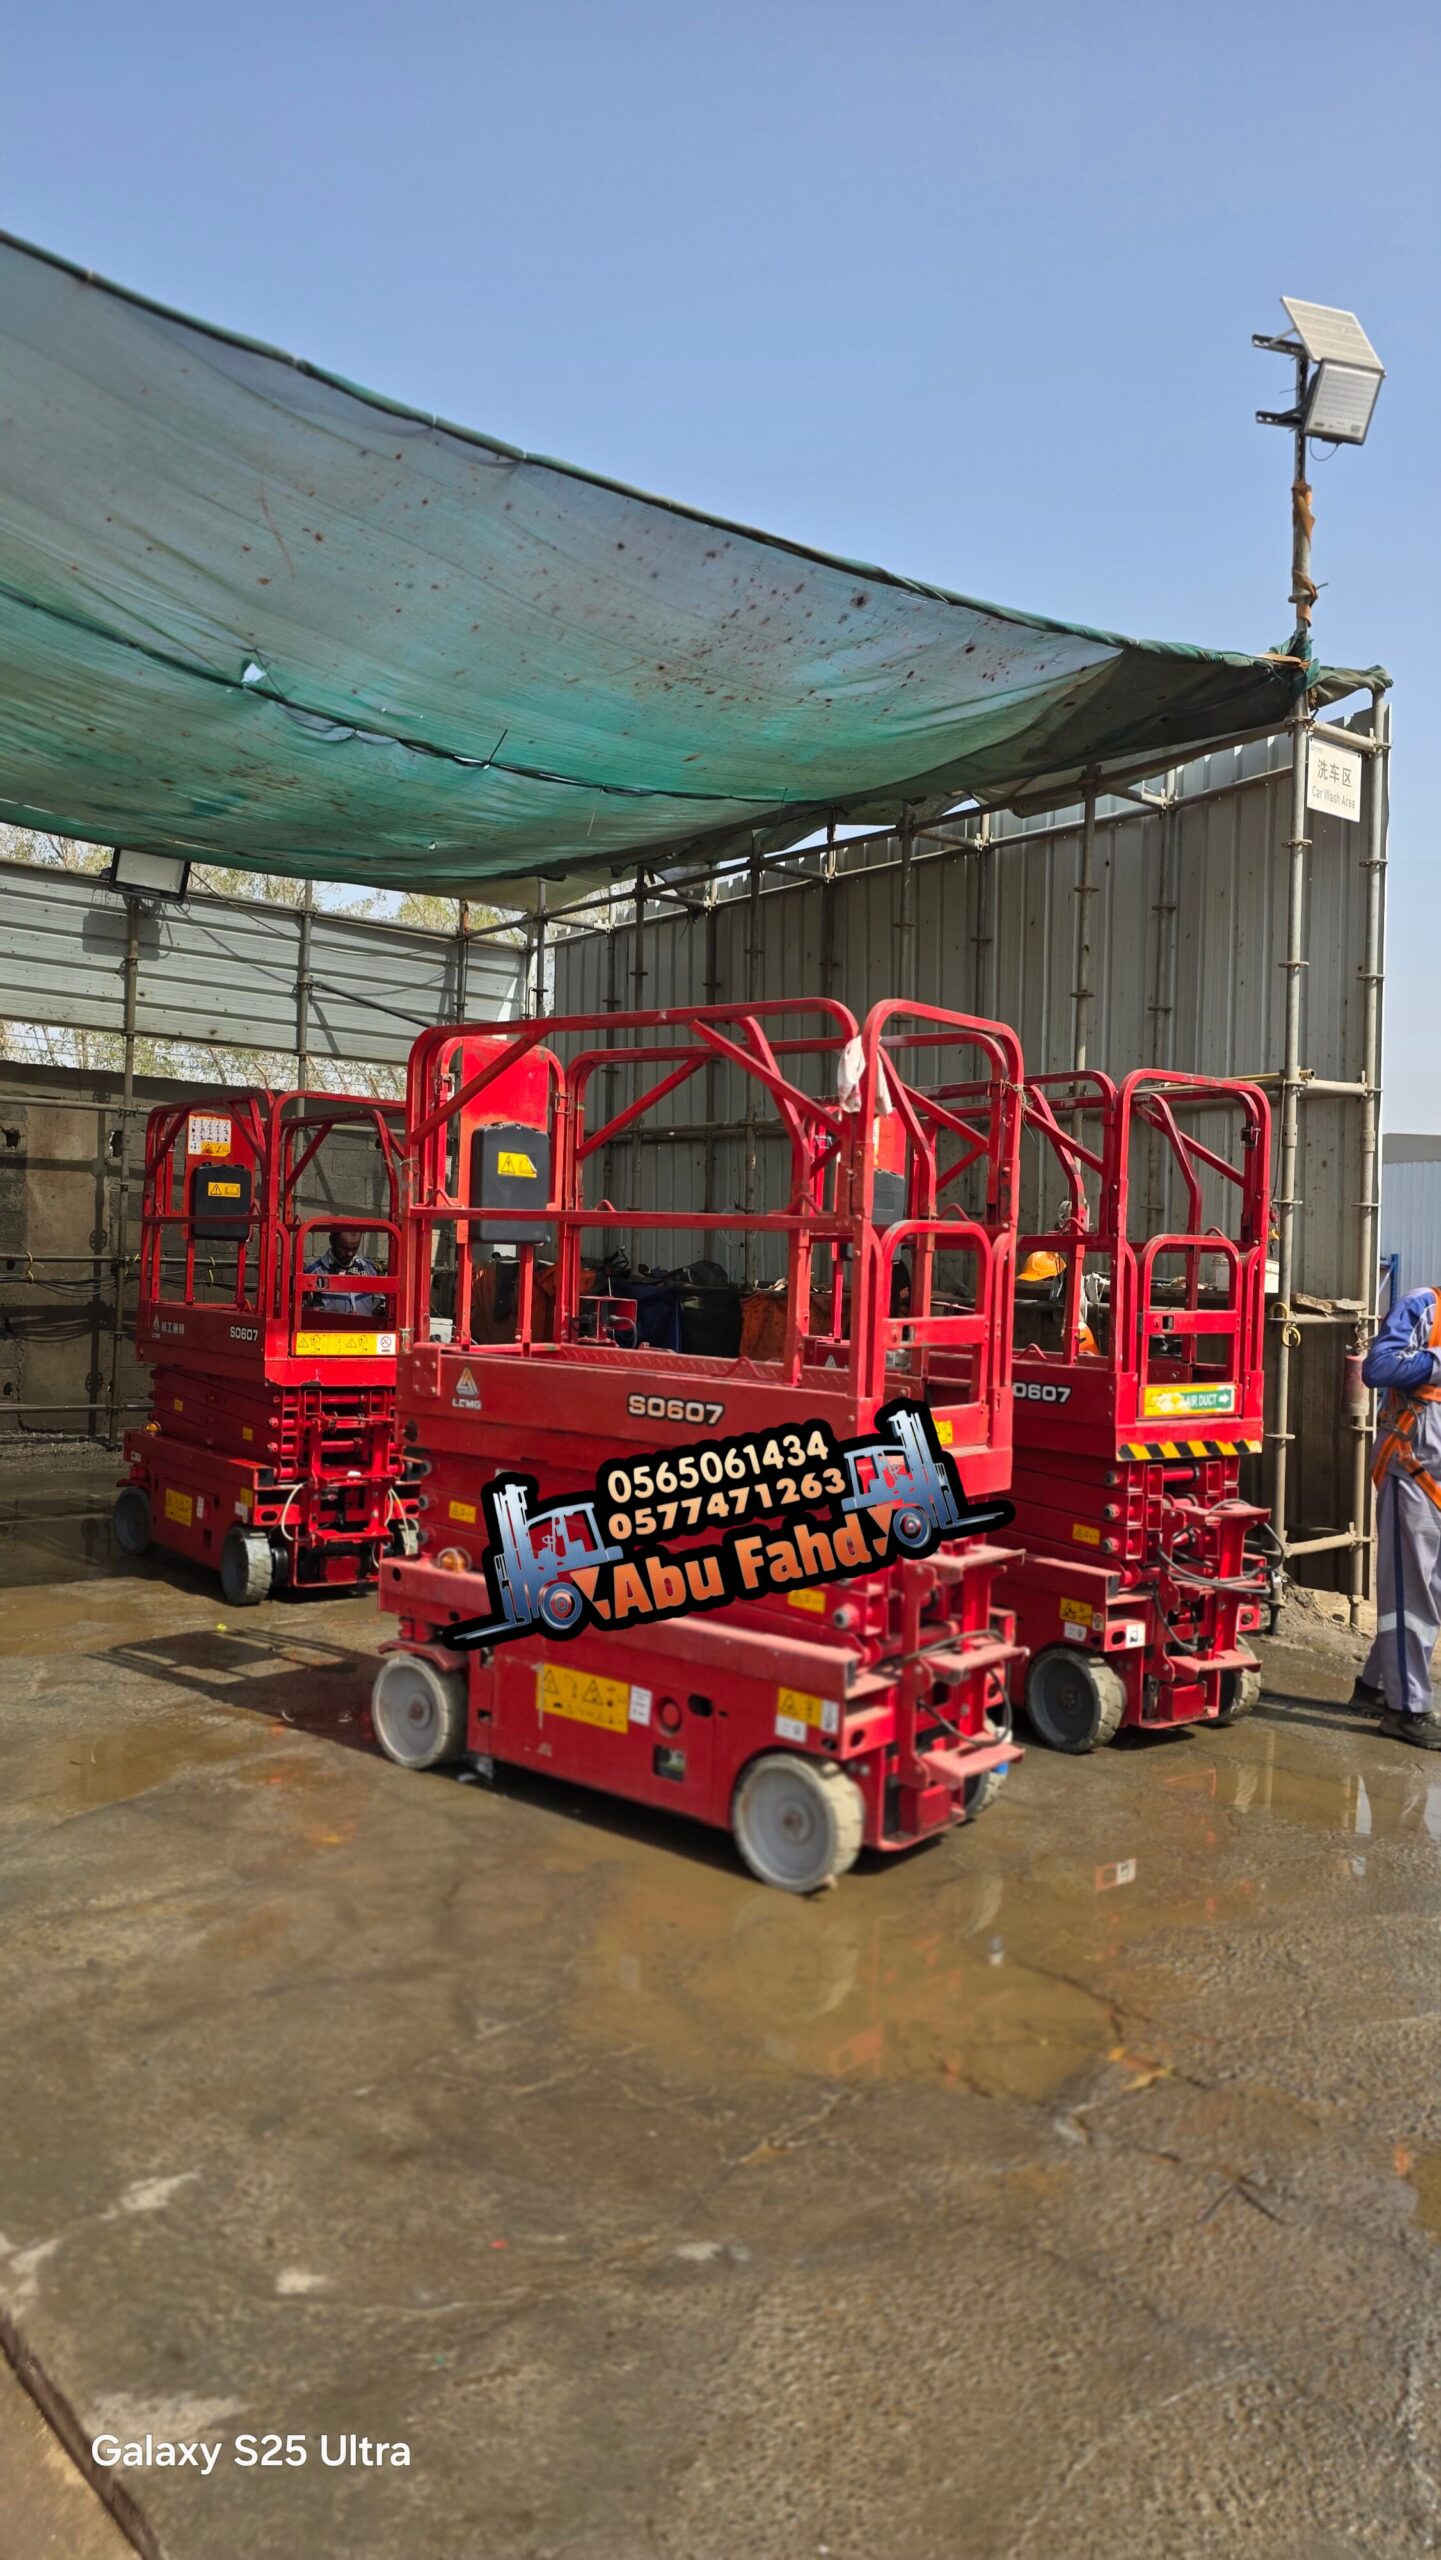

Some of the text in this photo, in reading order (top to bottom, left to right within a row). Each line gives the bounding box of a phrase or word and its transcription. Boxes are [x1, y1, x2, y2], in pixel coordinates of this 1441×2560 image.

[1317, 759, 1352, 788] 洗车区
[1312, 785, 1356, 809] Car Wash Area
[1013, 1382, 1071, 1403] 0607
[1199, 1393, 1218, 1407] DUCT
